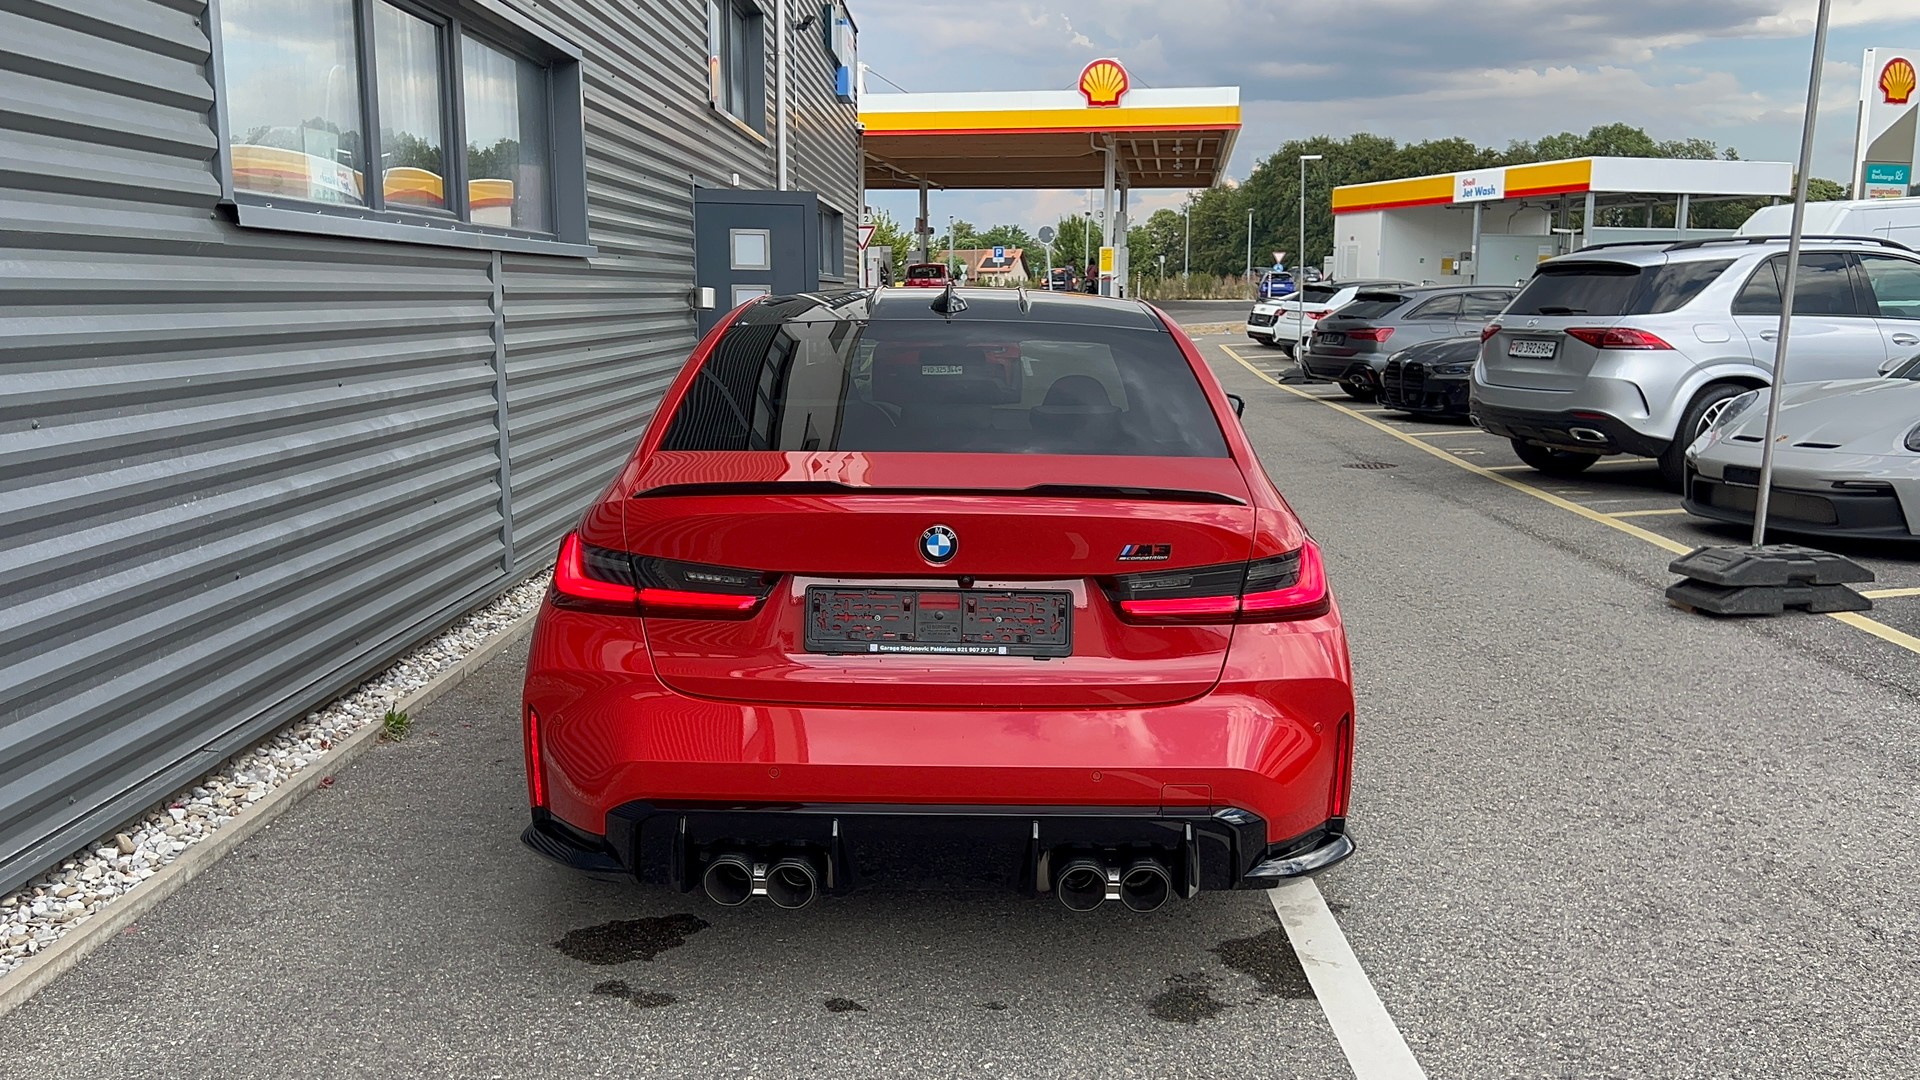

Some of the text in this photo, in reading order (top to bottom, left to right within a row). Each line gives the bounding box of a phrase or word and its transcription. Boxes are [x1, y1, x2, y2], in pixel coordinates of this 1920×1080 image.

[1462, 178, 1476, 187] Shell
[1462, 185, 1496, 198] Jet Wash
[1870, 187, 1901, 195] migrolino
[1098, 211, 1104, 219] 3
[995, 248, 1003, 257] P
[923, 526, 955, 540] BMW
[900, 645, 930, 653] Stojanovic
